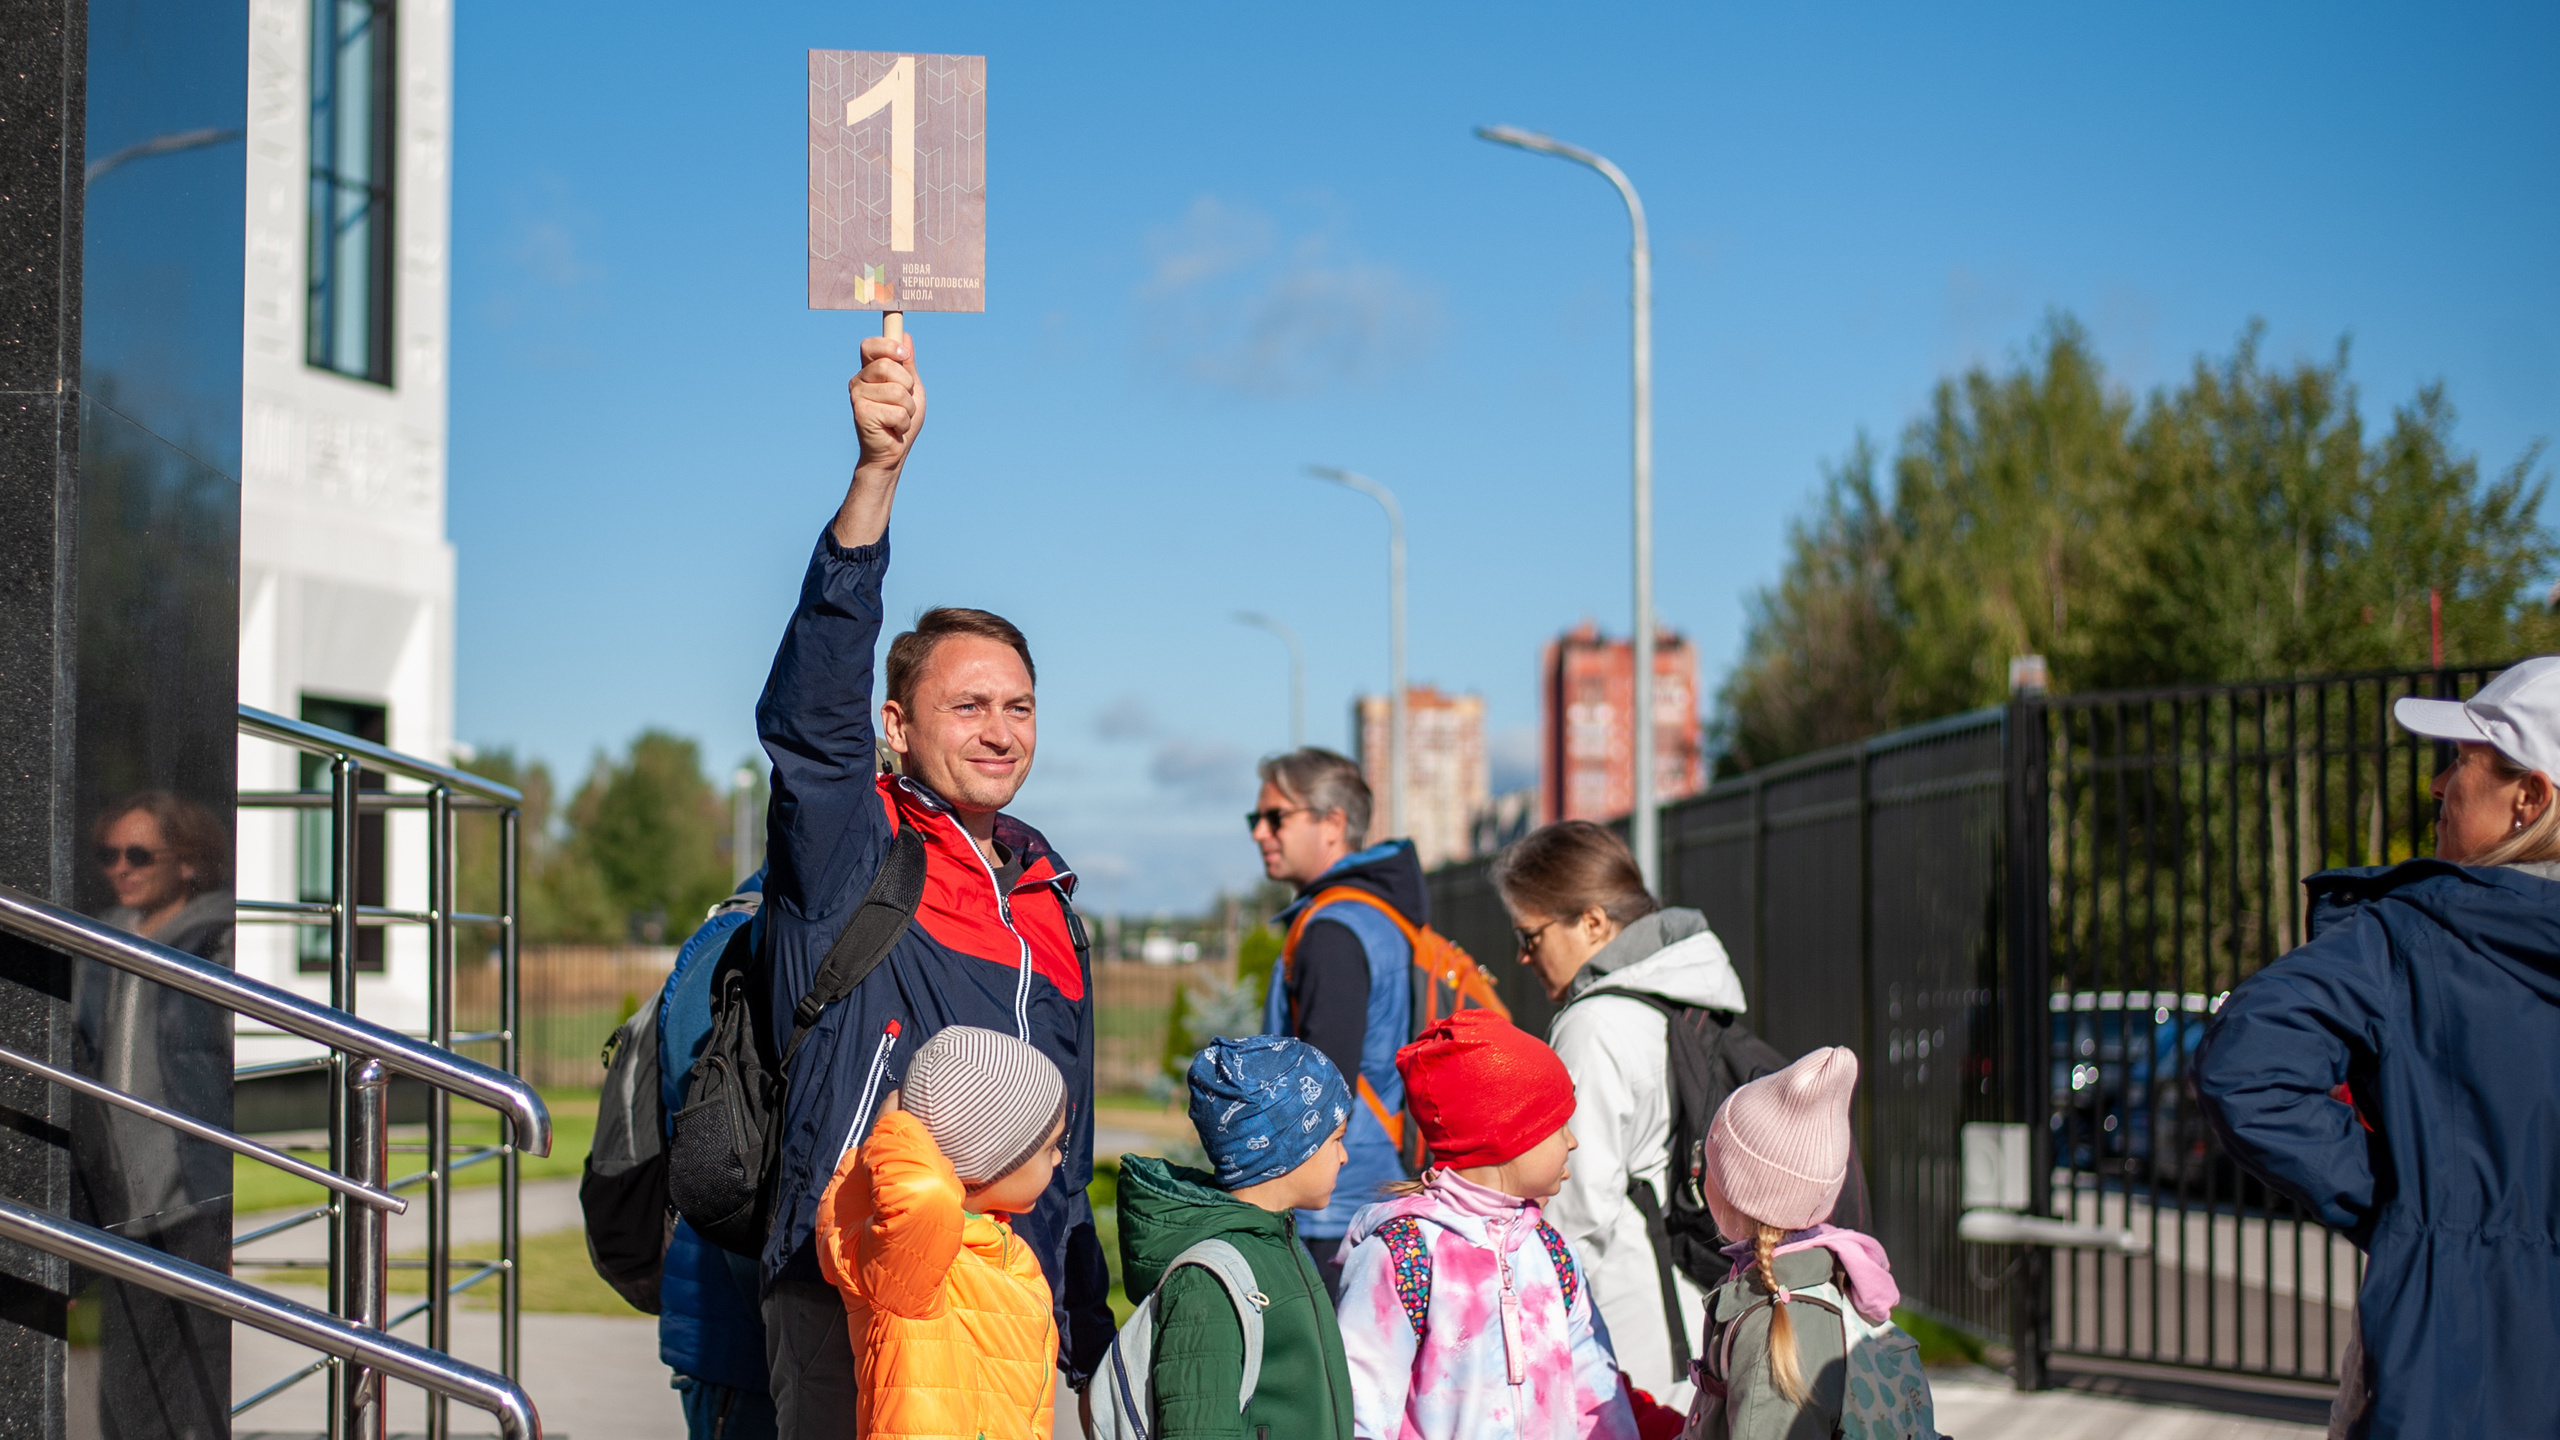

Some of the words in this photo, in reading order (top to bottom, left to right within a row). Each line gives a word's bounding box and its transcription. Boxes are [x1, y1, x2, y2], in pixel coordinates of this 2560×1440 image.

[847, 56, 915, 251] 1
[902, 263, 931, 274] НОВАЯ
[902, 276, 980, 289] ЧЕРНОГОЛОВСКАЯ
[902, 289, 934, 300] ШКОЛА
